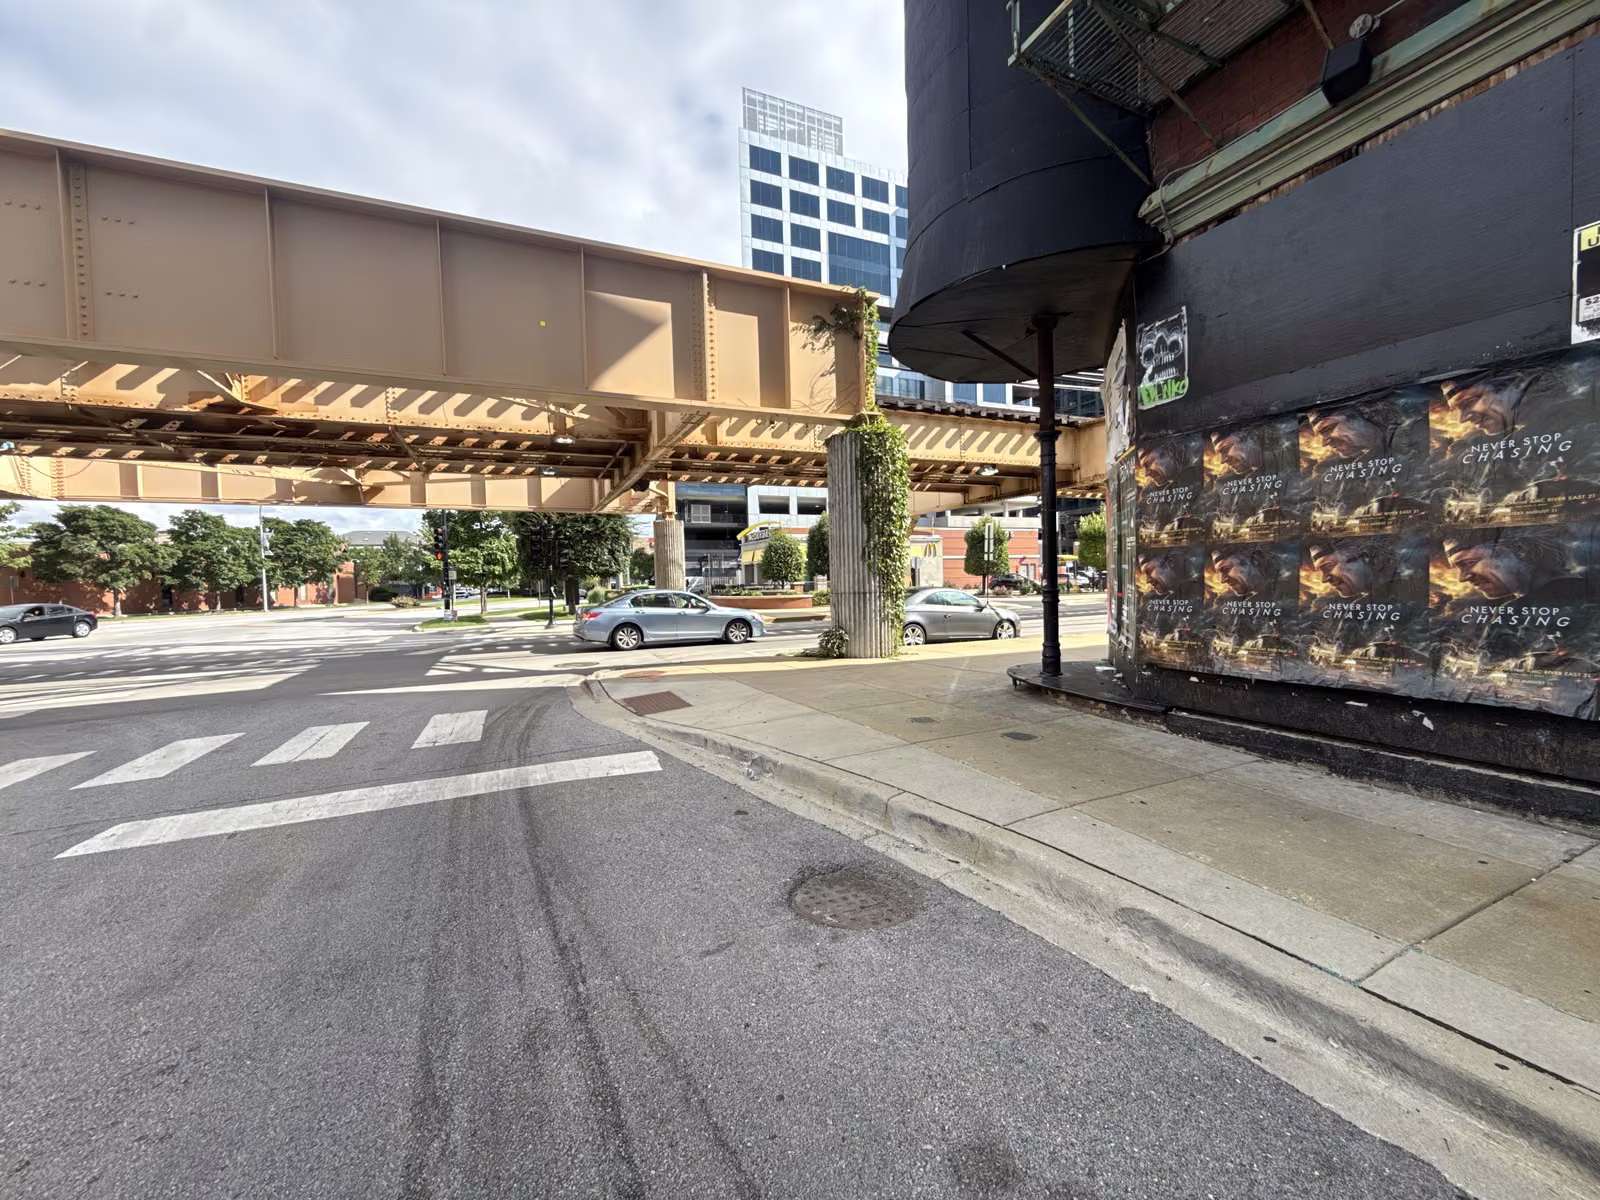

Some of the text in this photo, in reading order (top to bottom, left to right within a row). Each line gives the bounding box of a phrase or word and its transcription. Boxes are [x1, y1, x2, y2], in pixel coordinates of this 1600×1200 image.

[1471, 432, 1562, 453] NEVER STOP
[1462, 441, 1573, 464] CHASING
[1330, 457, 1395, 473] NEVER STOP
[1324, 463, 1402, 482] CHASING
[1226, 474, 1277, 487] NEVER STOP
[1150, 486, 1189, 497] NEVER STOP
[1222, 480, 1283, 495] CHASING
[1146, 492, 1193, 504] CHASING
[1146, 605, 1193, 613] CHASING
[1222, 607, 1282, 617] CHASING
[1328, 603, 1393, 612] NEVER STOP
[1470, 606, 1560, 616] NEVER STOP
[1322, 610, 1400, 621] CHASING
[1461, 614, 1571, 627] CHASING
